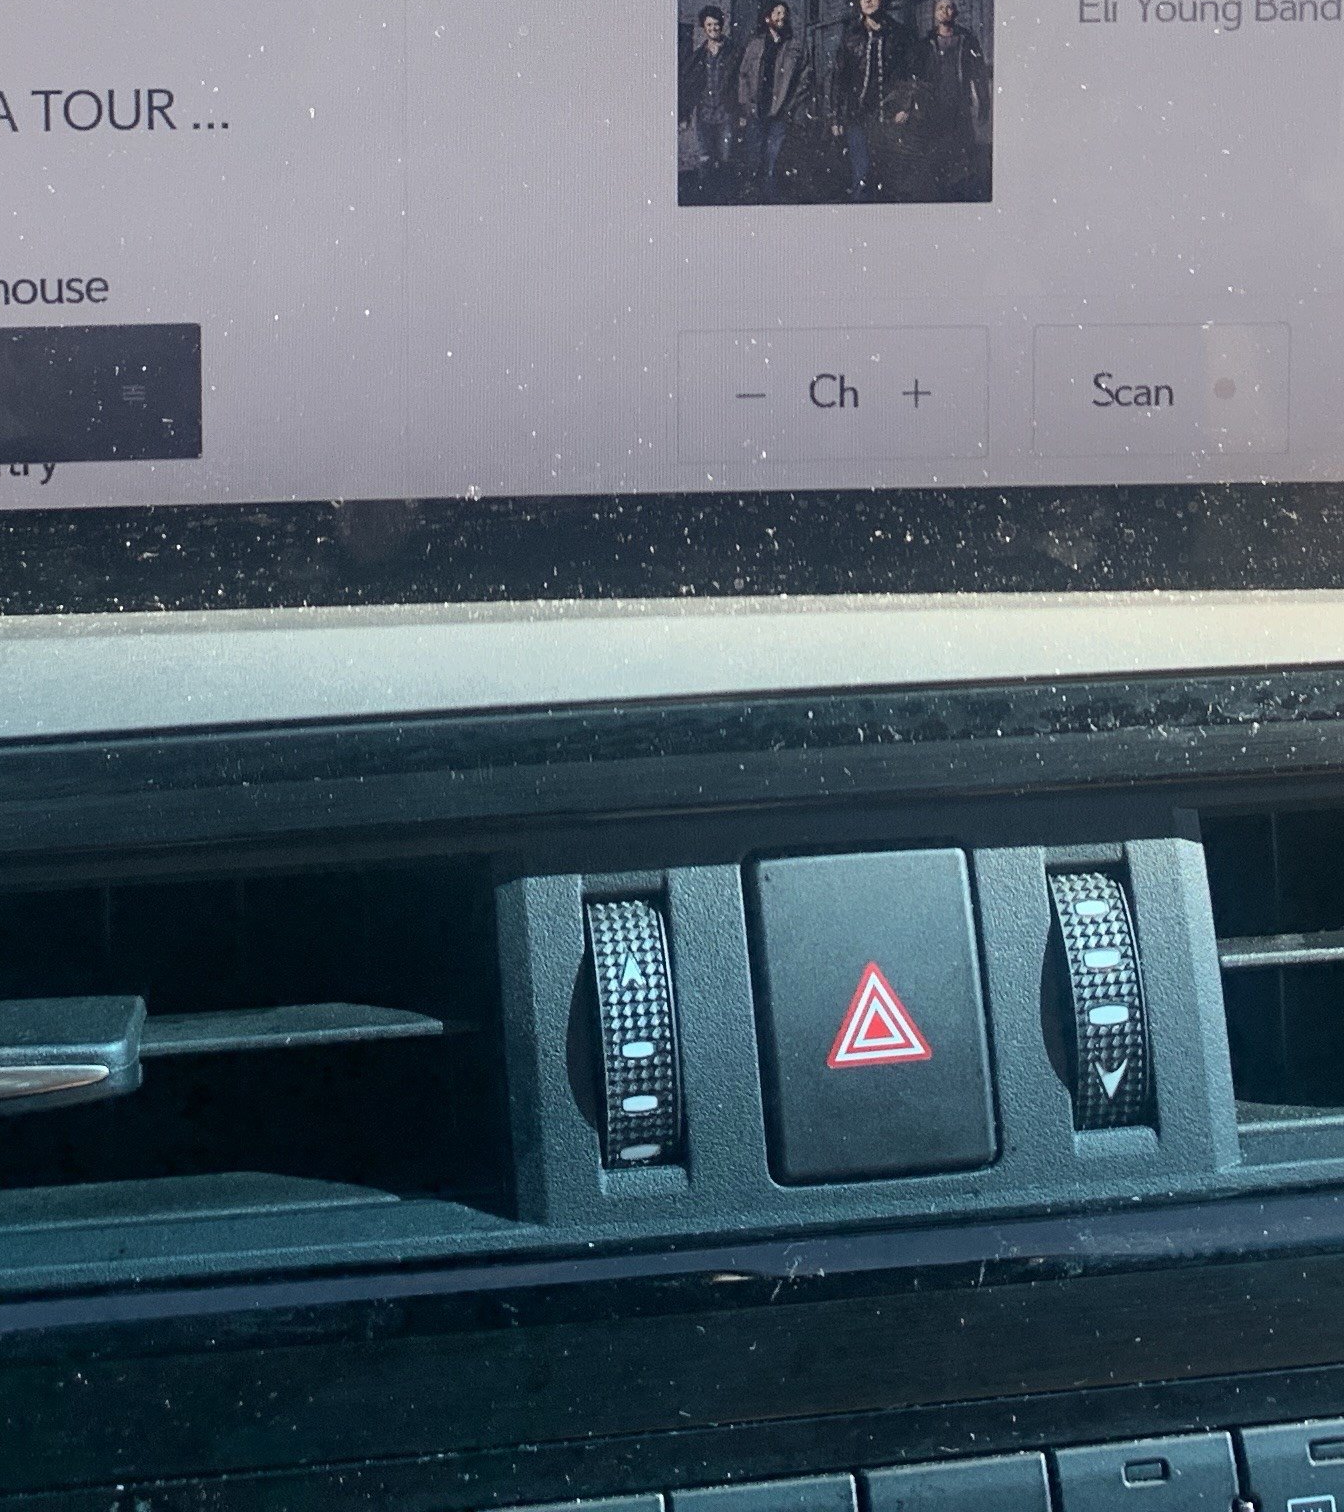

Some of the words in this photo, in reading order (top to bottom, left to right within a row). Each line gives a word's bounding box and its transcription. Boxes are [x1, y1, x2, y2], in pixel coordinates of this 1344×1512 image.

[30, 88, 178, 132] TOUR
[808, 373, 860, 410] Ch
[1092, 371, 1175, 409] Scan
